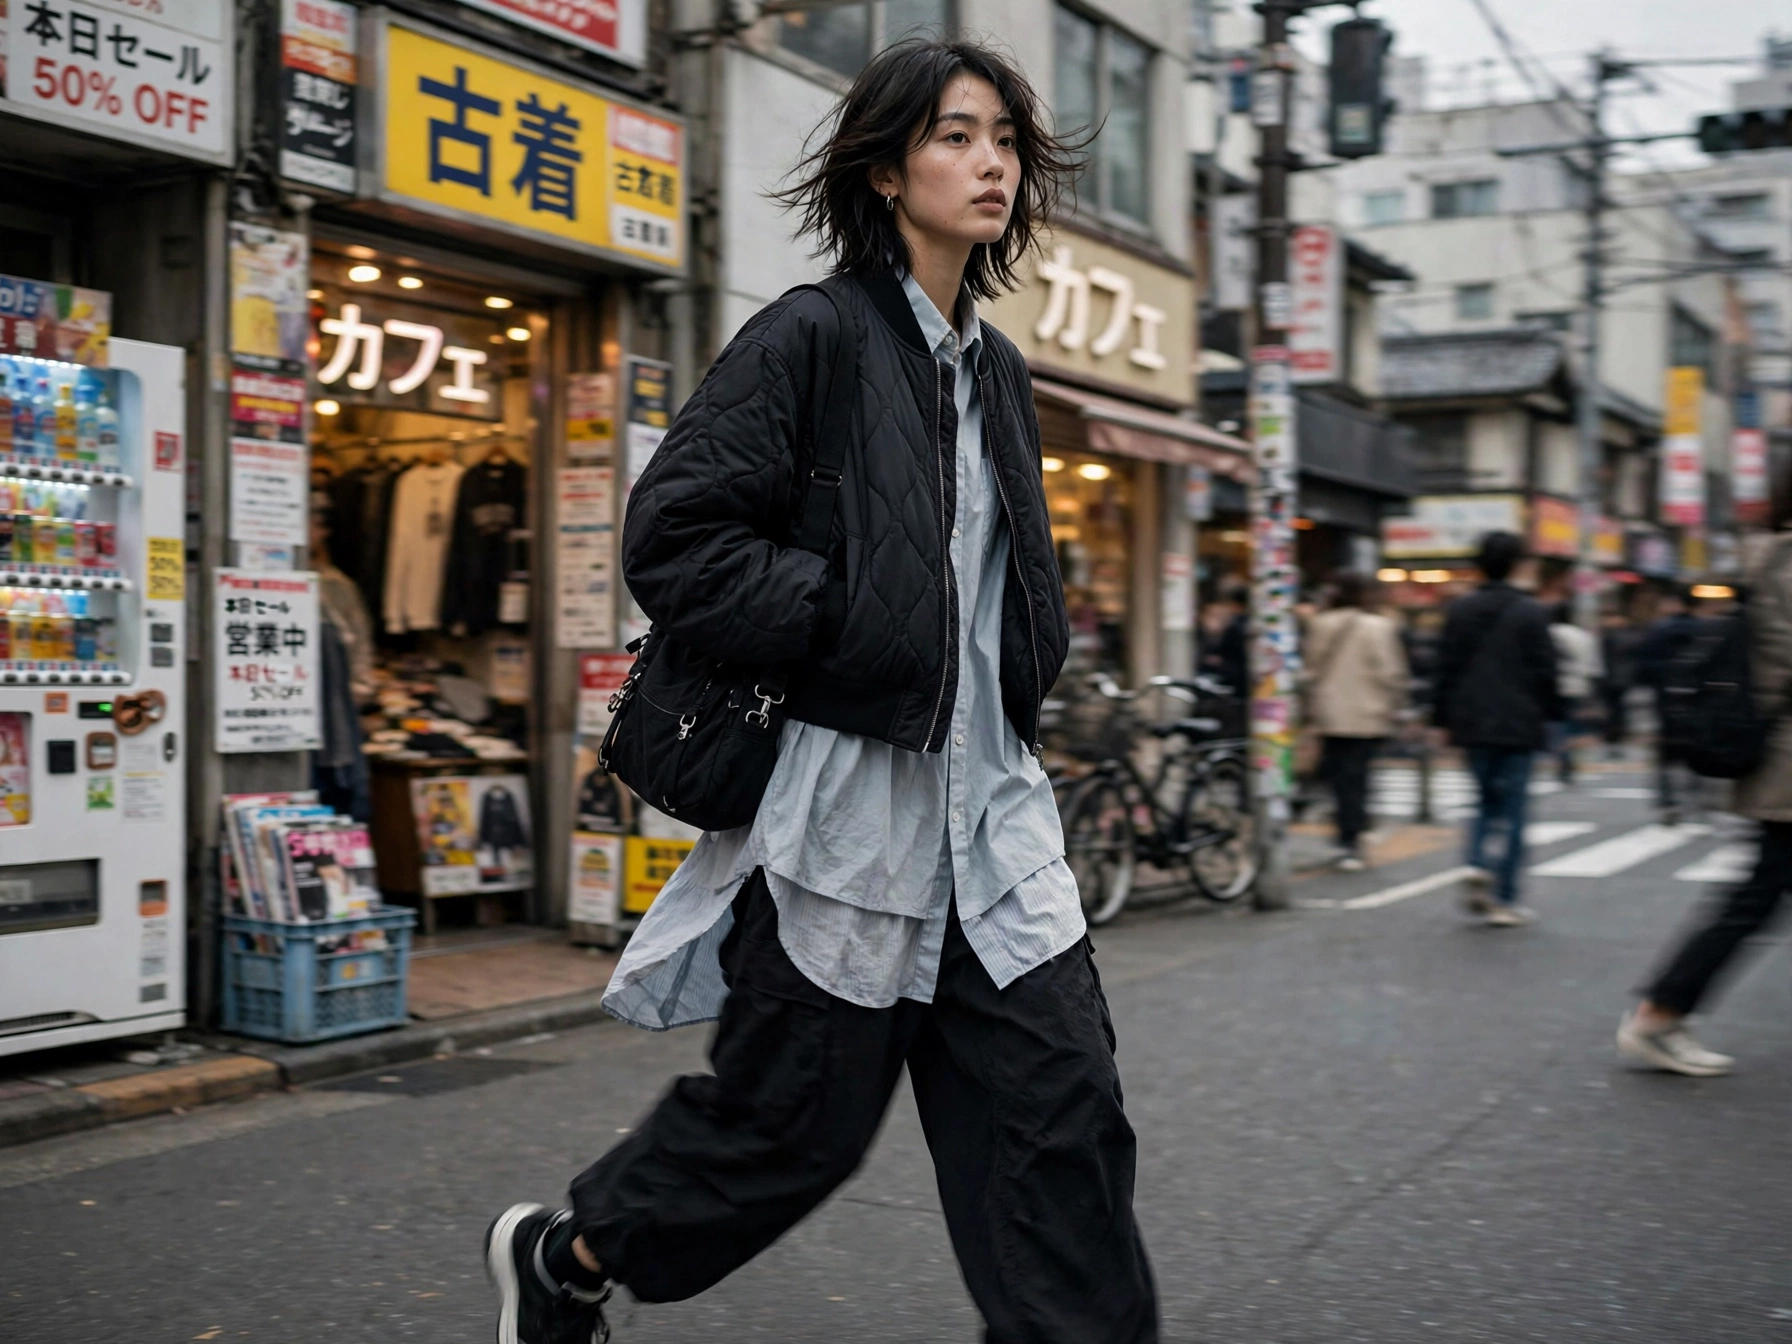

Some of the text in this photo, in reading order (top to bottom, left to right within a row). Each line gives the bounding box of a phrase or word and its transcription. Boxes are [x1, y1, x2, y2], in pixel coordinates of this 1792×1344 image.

[24, 1, 210, 86] 本日セール
[34, 56, 208, 133] 50% OFF
[418, 66, 584, 221] 古着
[1036, 245, 1168, 370] カフェ
[317, 304, 490, 404] カフェ
[226, 620, 307, 657] 営業中
